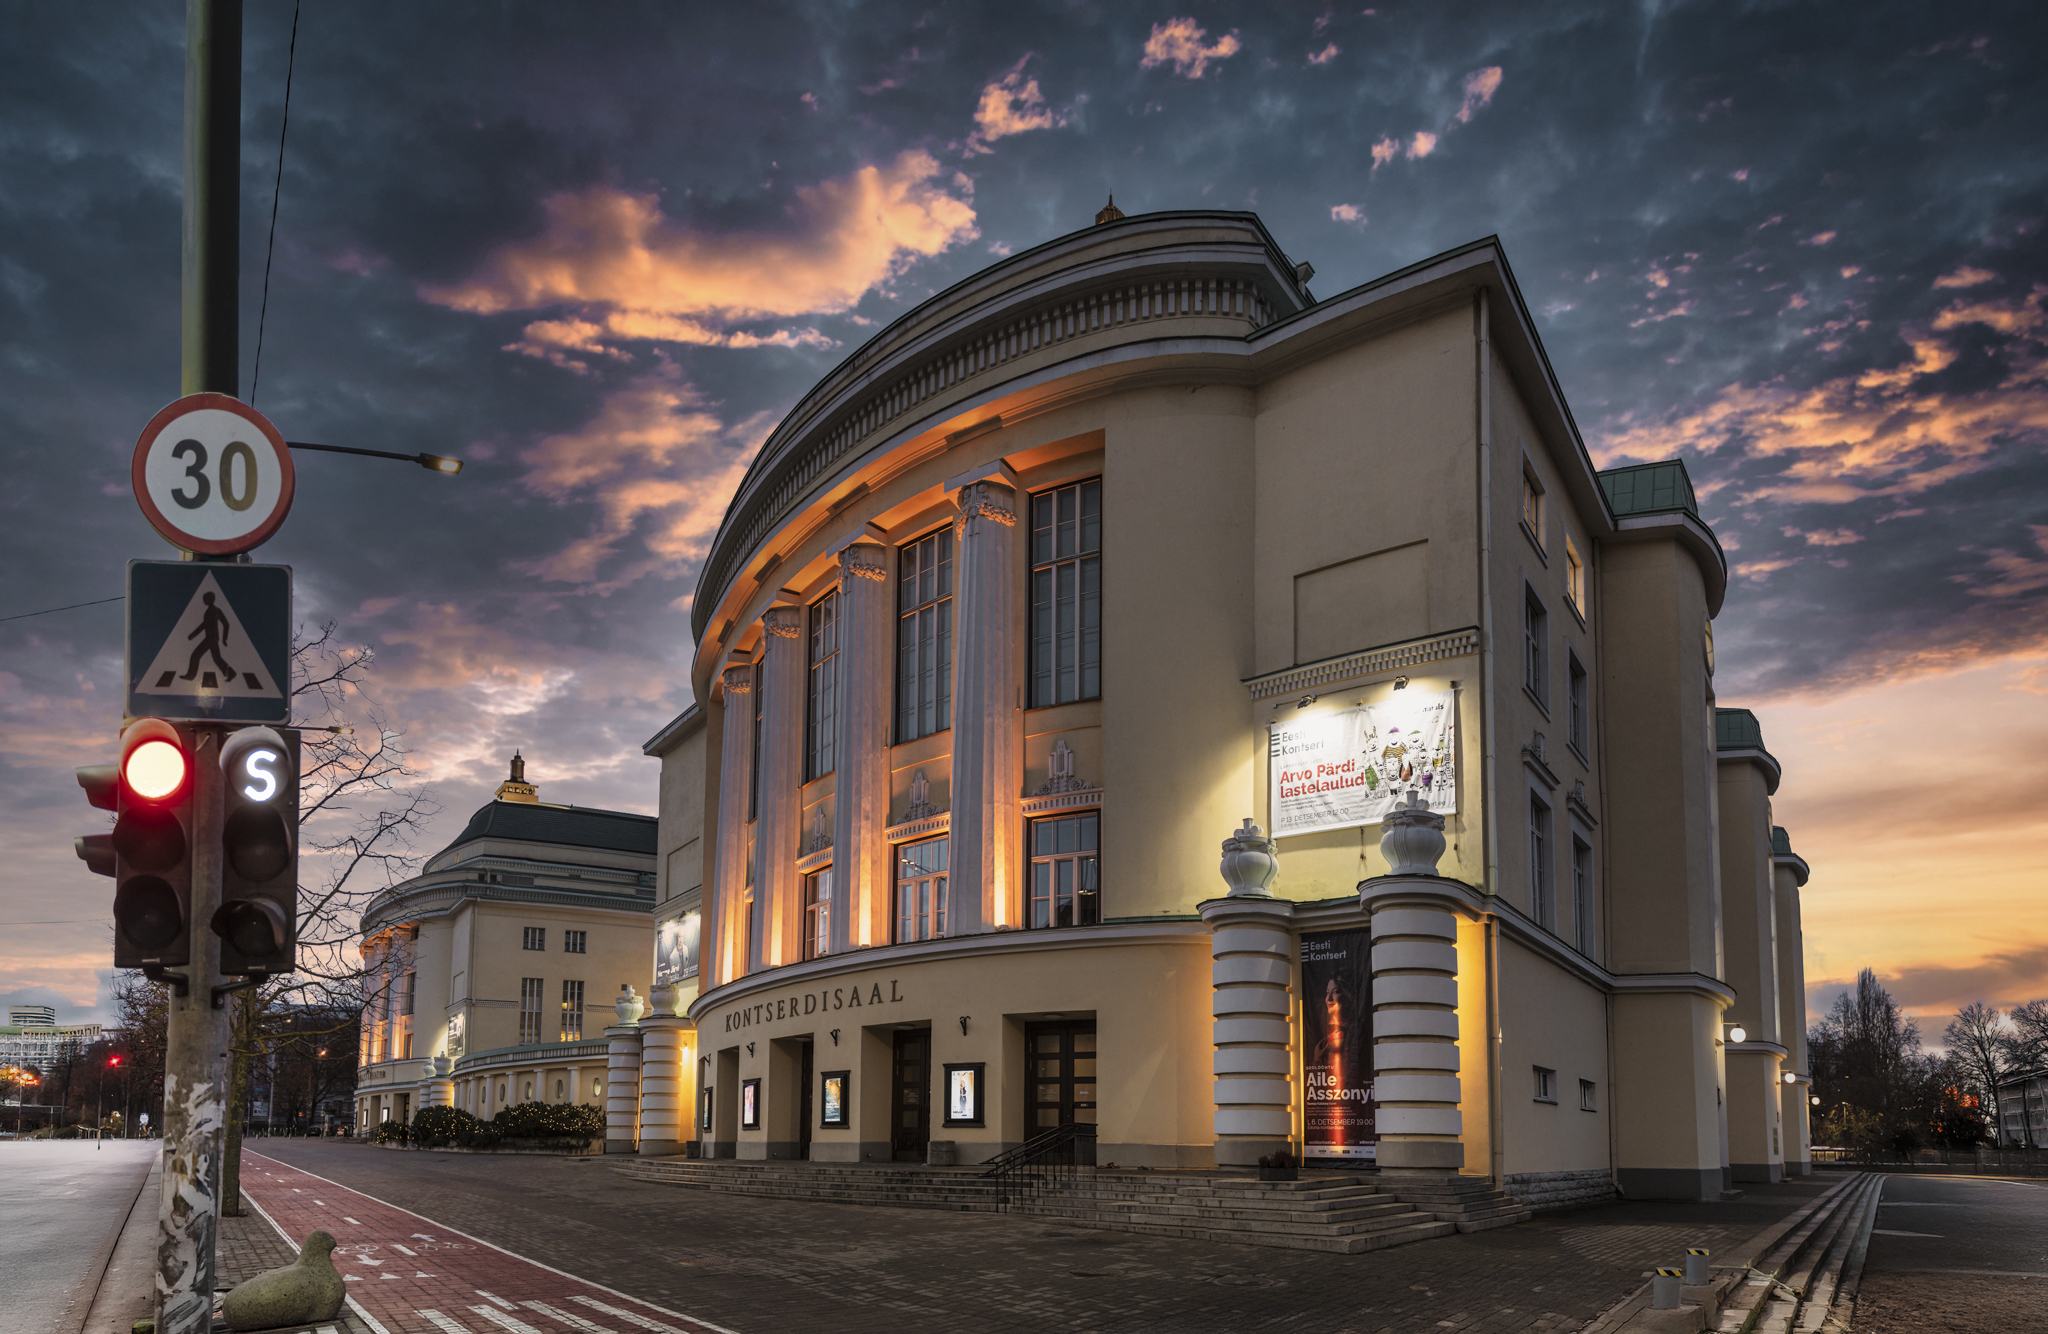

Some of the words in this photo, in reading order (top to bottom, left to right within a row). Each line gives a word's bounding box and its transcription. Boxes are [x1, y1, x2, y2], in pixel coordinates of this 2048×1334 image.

[171, 438, 258, 512] 30
[1282, 728, 1306, 743] Eesti
[244, 749, 277, 802] S
[1280, 768, 1313, 785] Arvo
[1316, 758, 1355, 778] Pärdi
[1280, 771, 1365, 799] lastelaulud
[1294, 810, 1332, 822] DETSEMBER
[1310, 940, 1331, 951] Eesti
[1310, 950, 1347, 961] Kontsert
[725, 979, 904, 1033] KONTSERDISAAL
[1306, 1072, 1337, 1087] Aile
[1306, 1085, 1375, 1104] Asszonyi
[1318, 1118, 1355, 1126] DETSEMBER
